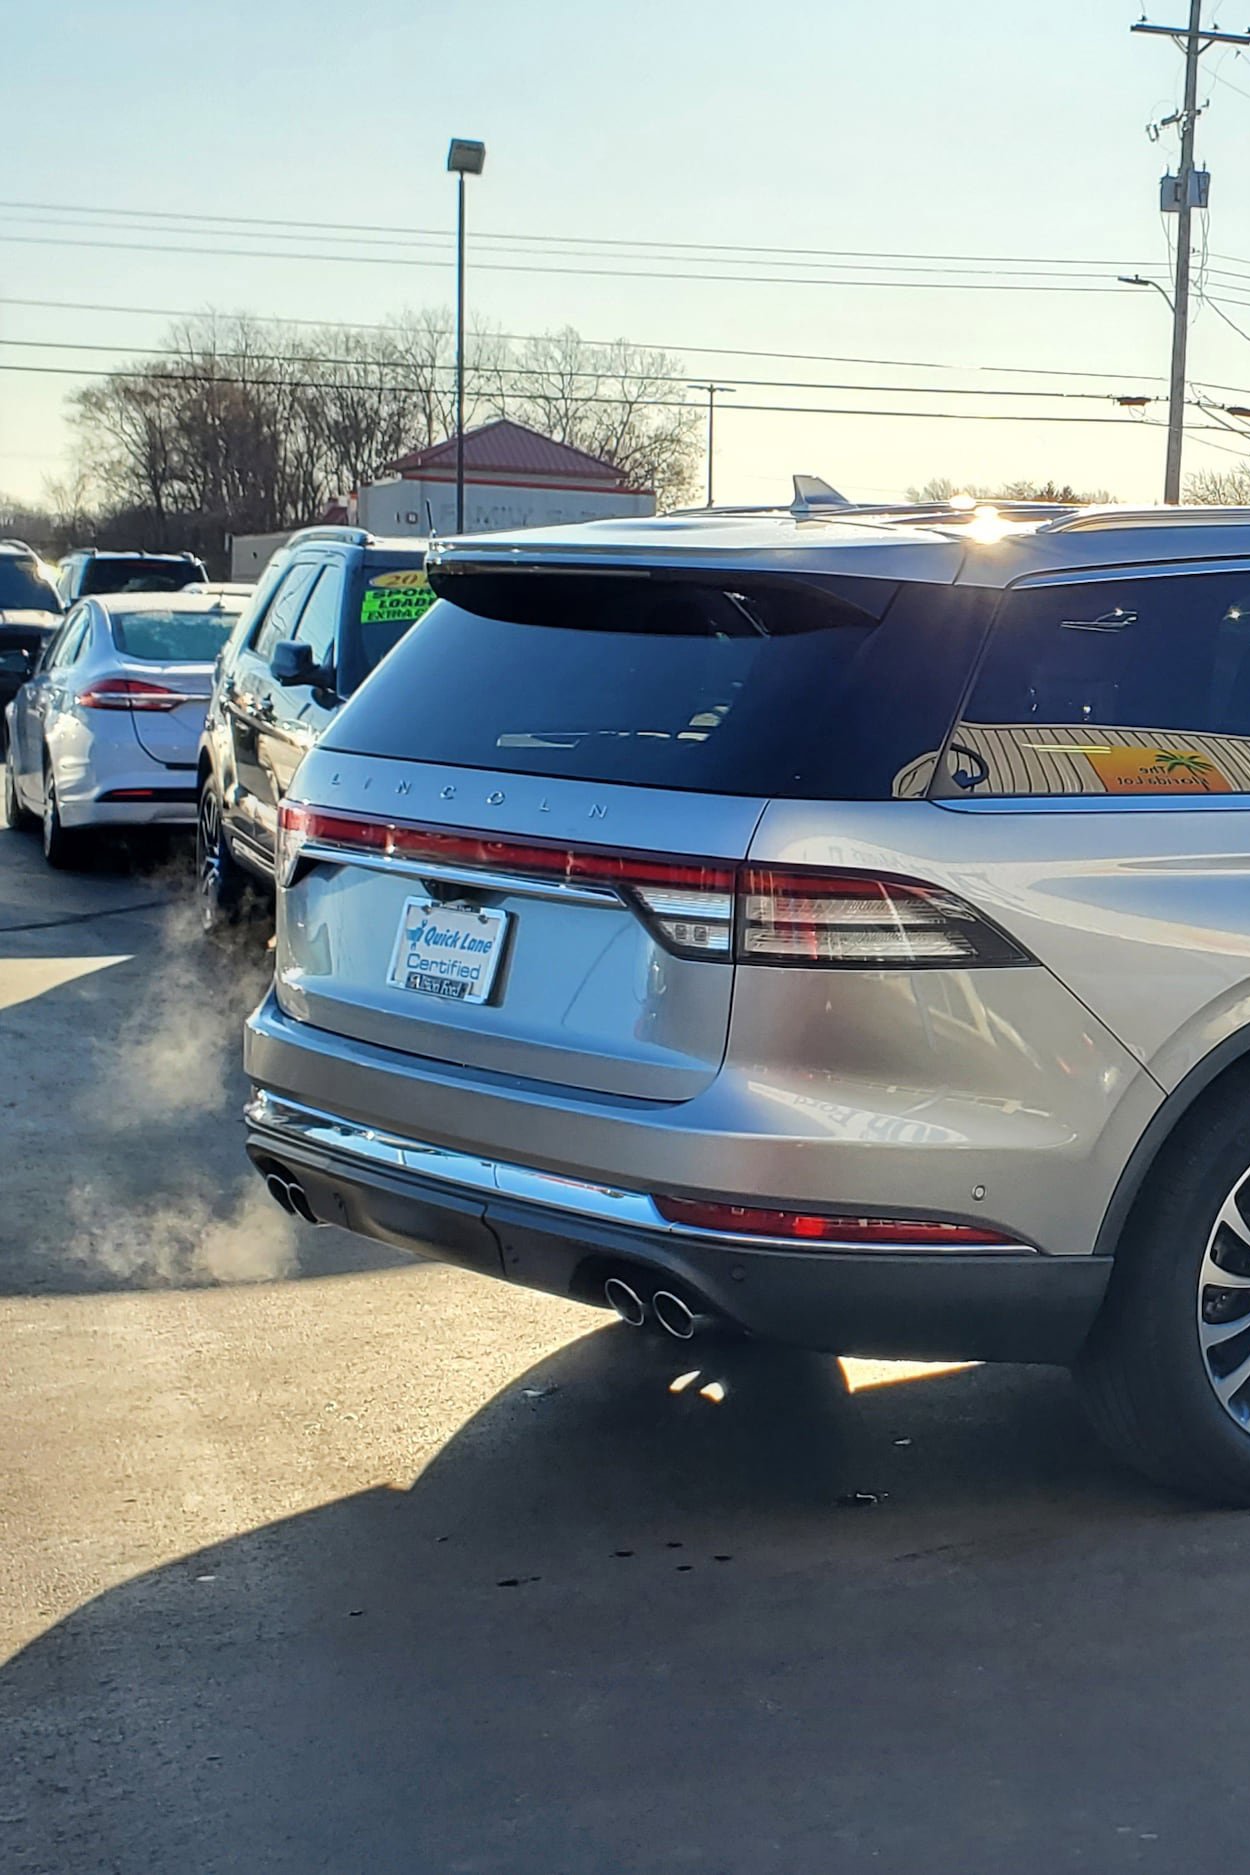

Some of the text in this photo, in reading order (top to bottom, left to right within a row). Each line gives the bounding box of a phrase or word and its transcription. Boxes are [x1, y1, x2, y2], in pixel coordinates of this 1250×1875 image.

[331, 773, 608, 819] LINCOLN
[424, 926, 493, 954] Quick Lane
[407, 952, 481, 980] Certified
